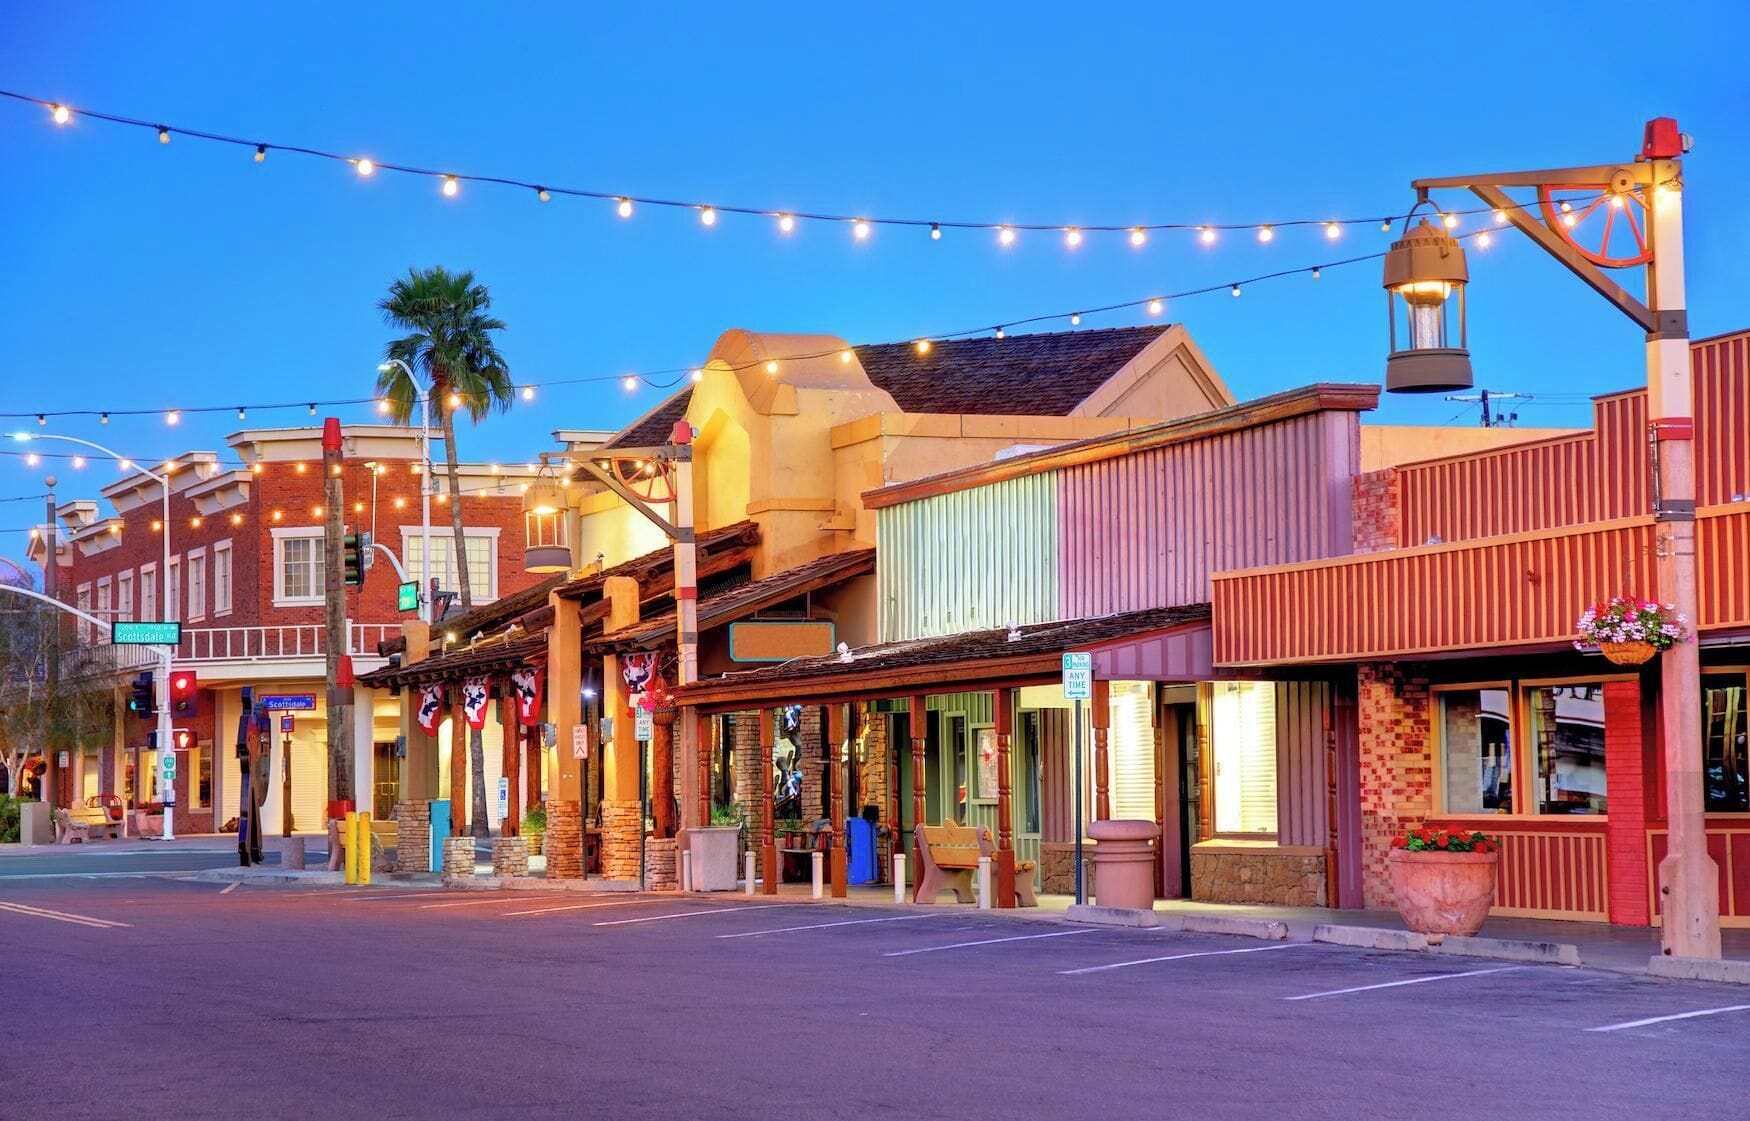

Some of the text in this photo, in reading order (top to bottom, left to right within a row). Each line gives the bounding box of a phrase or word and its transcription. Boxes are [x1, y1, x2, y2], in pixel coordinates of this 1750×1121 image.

[118, 632, 164, 642] Scottsdale
[1065, 656, 1072, 669] 3
[1069, 672, 1085, 680] ANY
[1069, 681, 1086, 689] TIME
